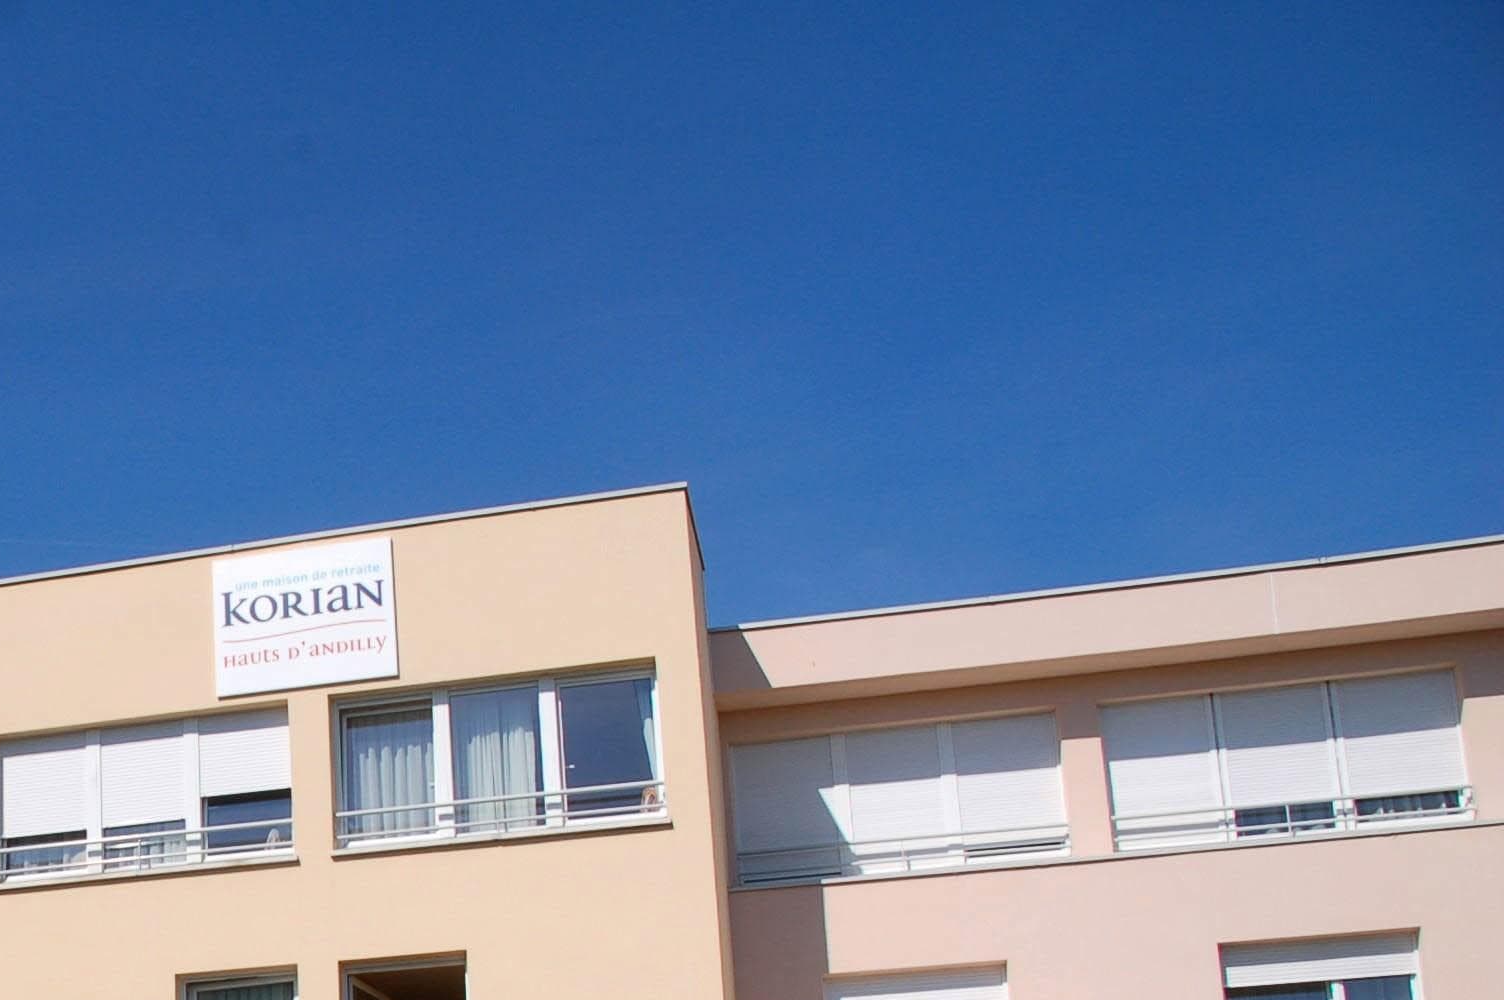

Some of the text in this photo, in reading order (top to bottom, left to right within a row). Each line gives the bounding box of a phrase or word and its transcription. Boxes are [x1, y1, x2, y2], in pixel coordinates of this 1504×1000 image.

[235, 563, 380, 592] une maison de retraite
